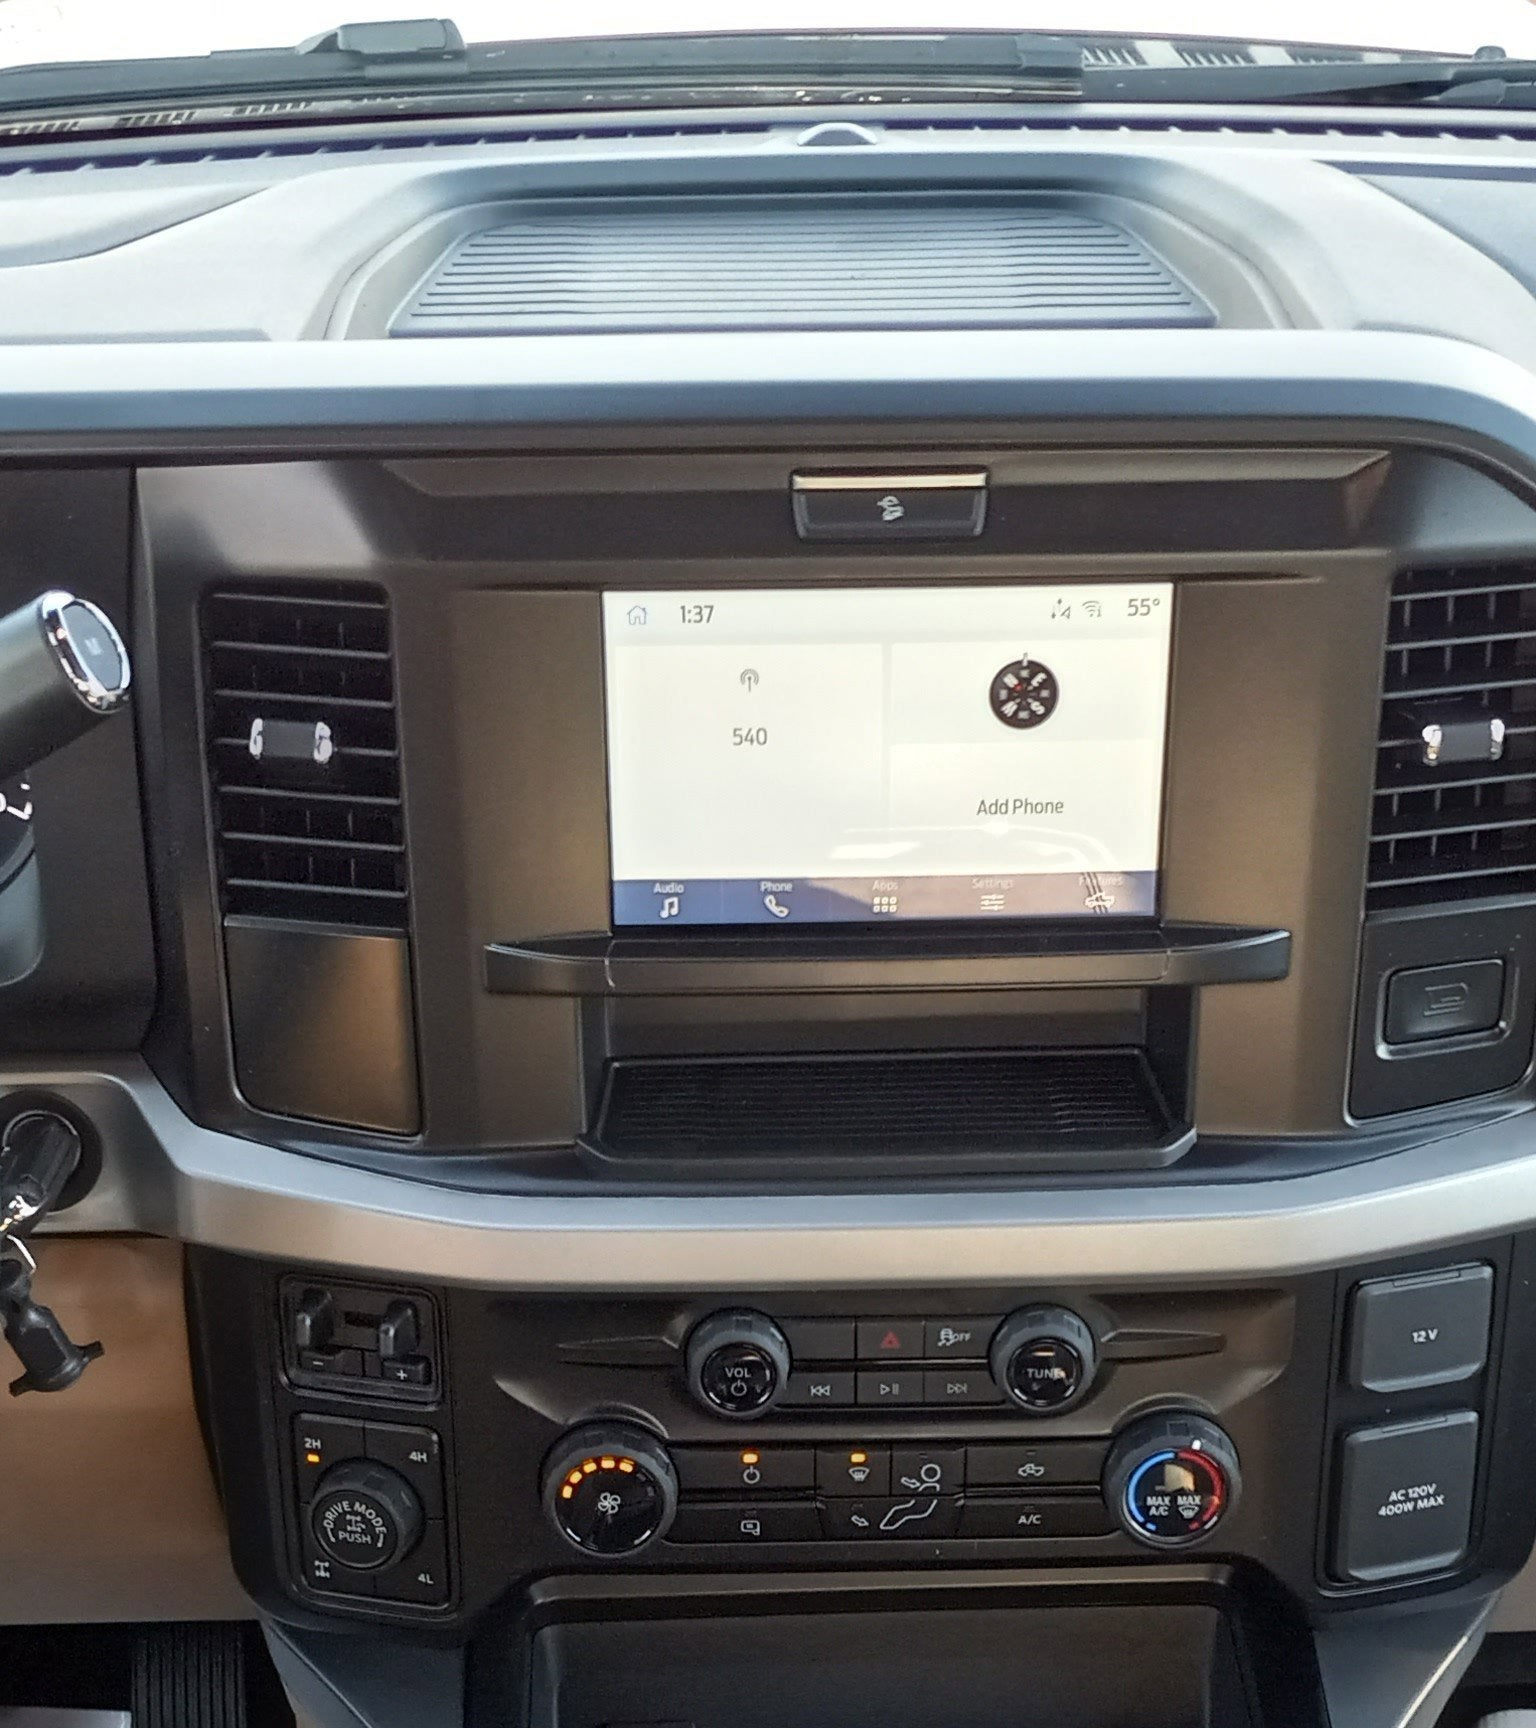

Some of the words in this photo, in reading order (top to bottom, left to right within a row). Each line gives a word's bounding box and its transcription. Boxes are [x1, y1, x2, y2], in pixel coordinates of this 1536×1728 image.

[680, 605, 714, 624] 1:37
[732, 727, 768, 747] 540
[976, 798, 1009, 816] Add
[1012, 797, 1064, 815] Phone
[653, 881, 684, 894] Audio
[760, 880, 793, 893] Phone
[1412, 1330, 1426, 1343] 12
[1428, 1328, 1438, 1341] V
[725, 1367, 752, 1378] VOL
[304, 1437, 322, 1449] 2H
[409, 1451, 428, 1463] 4H
[1388, 1489, 1406, 1502] AC
[1407, 1483, 1437, 1499] 120V
[1146, 1495, 1171, 1507] MAX
[1177, 1494, 1202, 1505] MAX
[1378, 1501, 1415, 1516] 400W
[1416, 1494, 1445, 1510] MAX
[1149, 1505, 1169, 1516] A/C
[323, 1500, 351, 1529] DRIVE
[353, 1501, 388, 1535] MODE
[1018, 1514, 1042, 1525] A/C
[338, 1531, 372, 1544] PUSH
[417, 1573, 434, 1585] 4L
